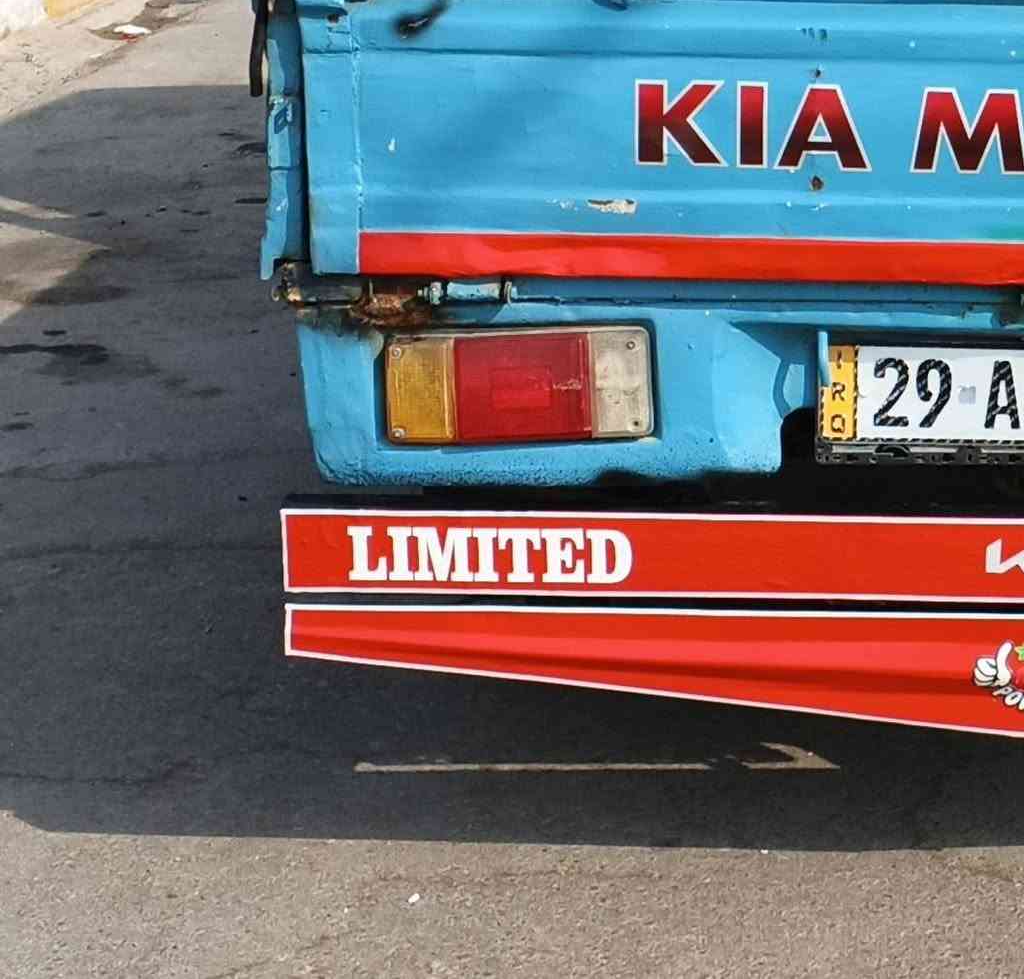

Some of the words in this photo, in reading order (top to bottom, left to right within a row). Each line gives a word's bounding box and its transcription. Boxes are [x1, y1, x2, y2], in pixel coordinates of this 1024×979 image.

[634, 78, 871, 173] KIA
[830, 349, 846, 433] IRQ
[873, 357, 952, 430] 29
[984, 359, 1021, 430] A
[347, 525, 633, 584] LIMITED
